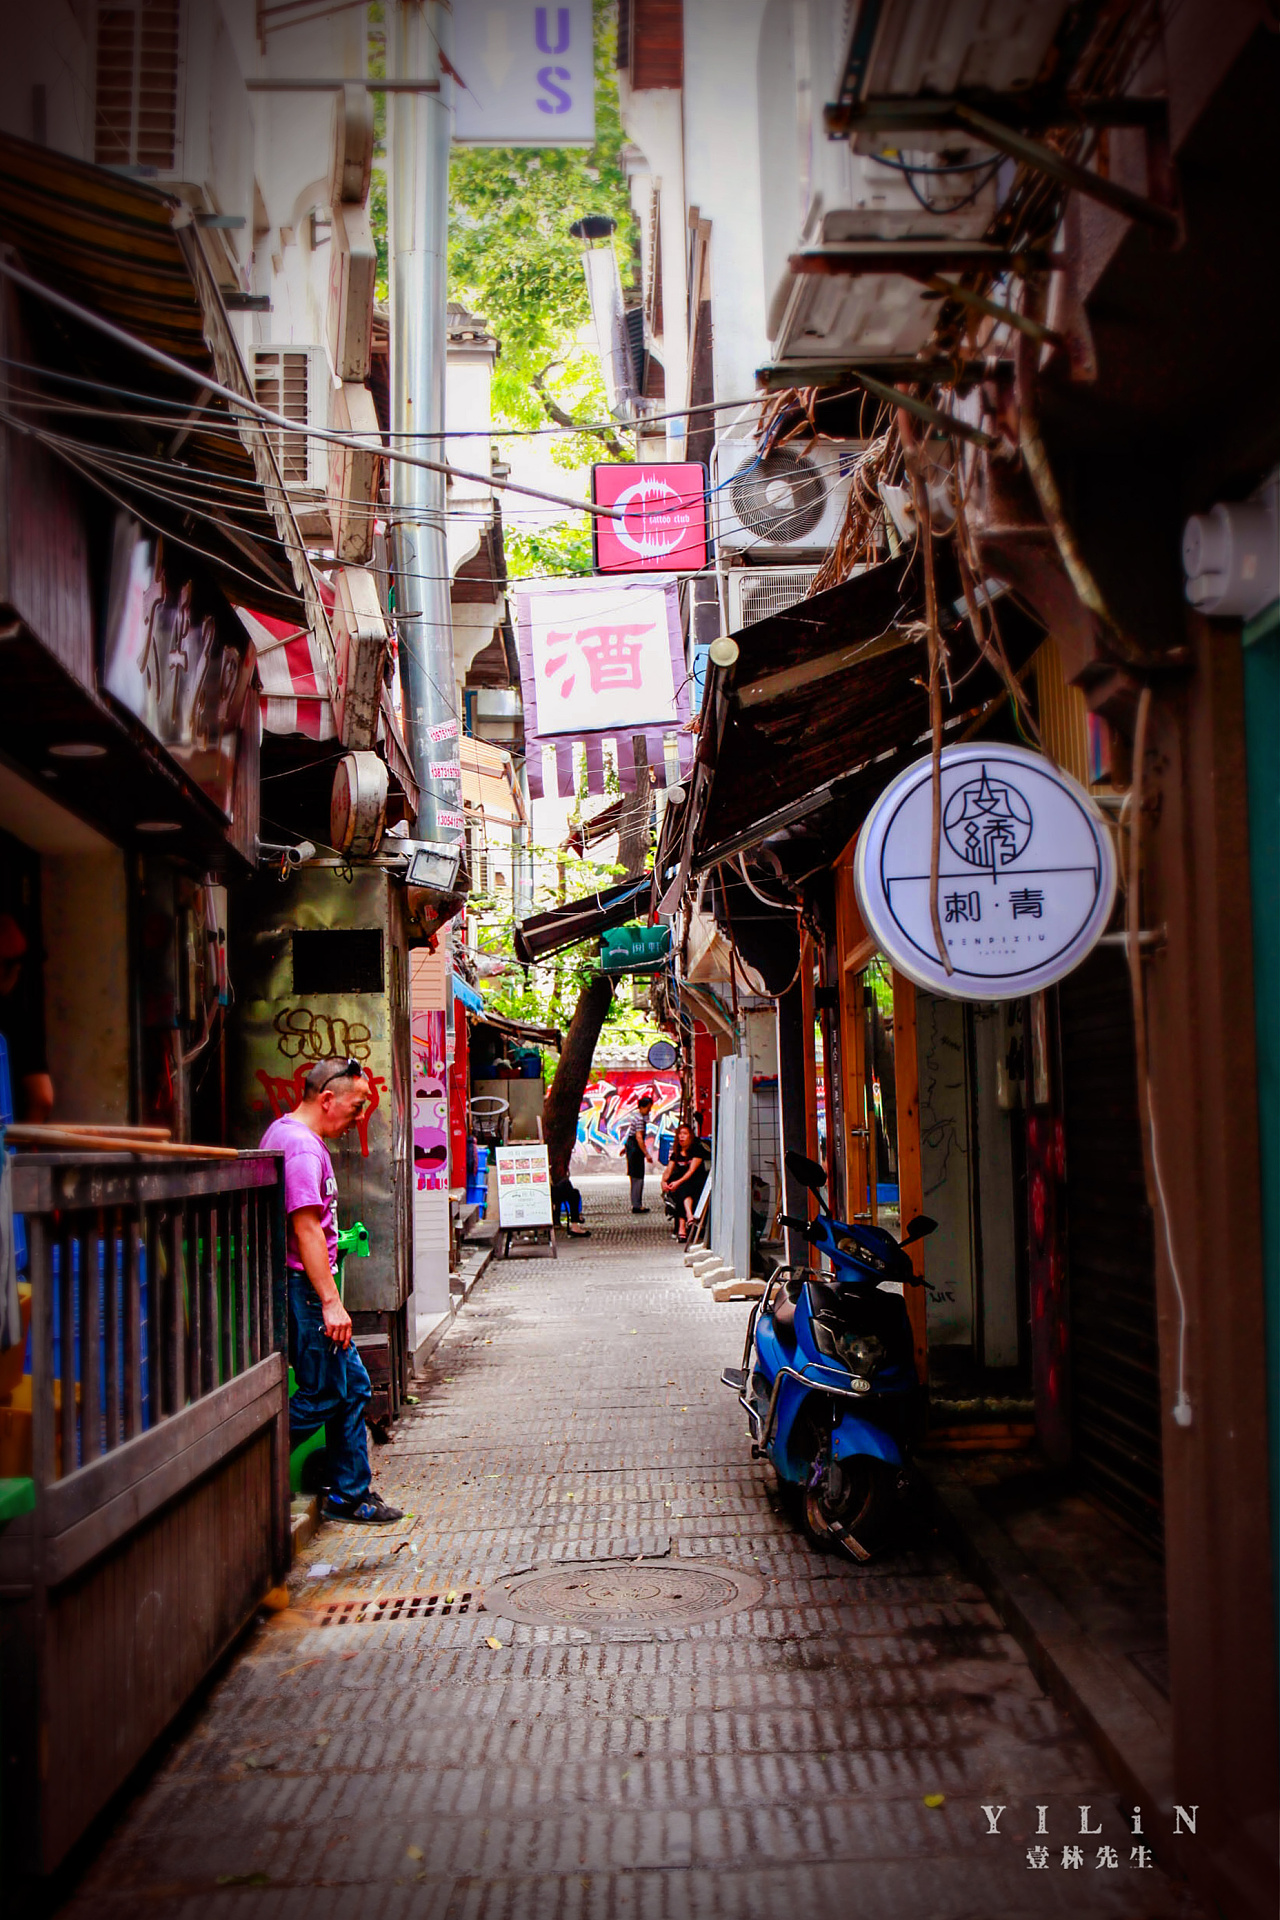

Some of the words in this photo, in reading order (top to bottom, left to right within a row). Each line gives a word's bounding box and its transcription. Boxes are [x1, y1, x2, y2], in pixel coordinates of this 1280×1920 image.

[649, 515, 671, 524] tattoo
[674, 514, 690, 524] club
[544, 621, 657, 699] 酒
